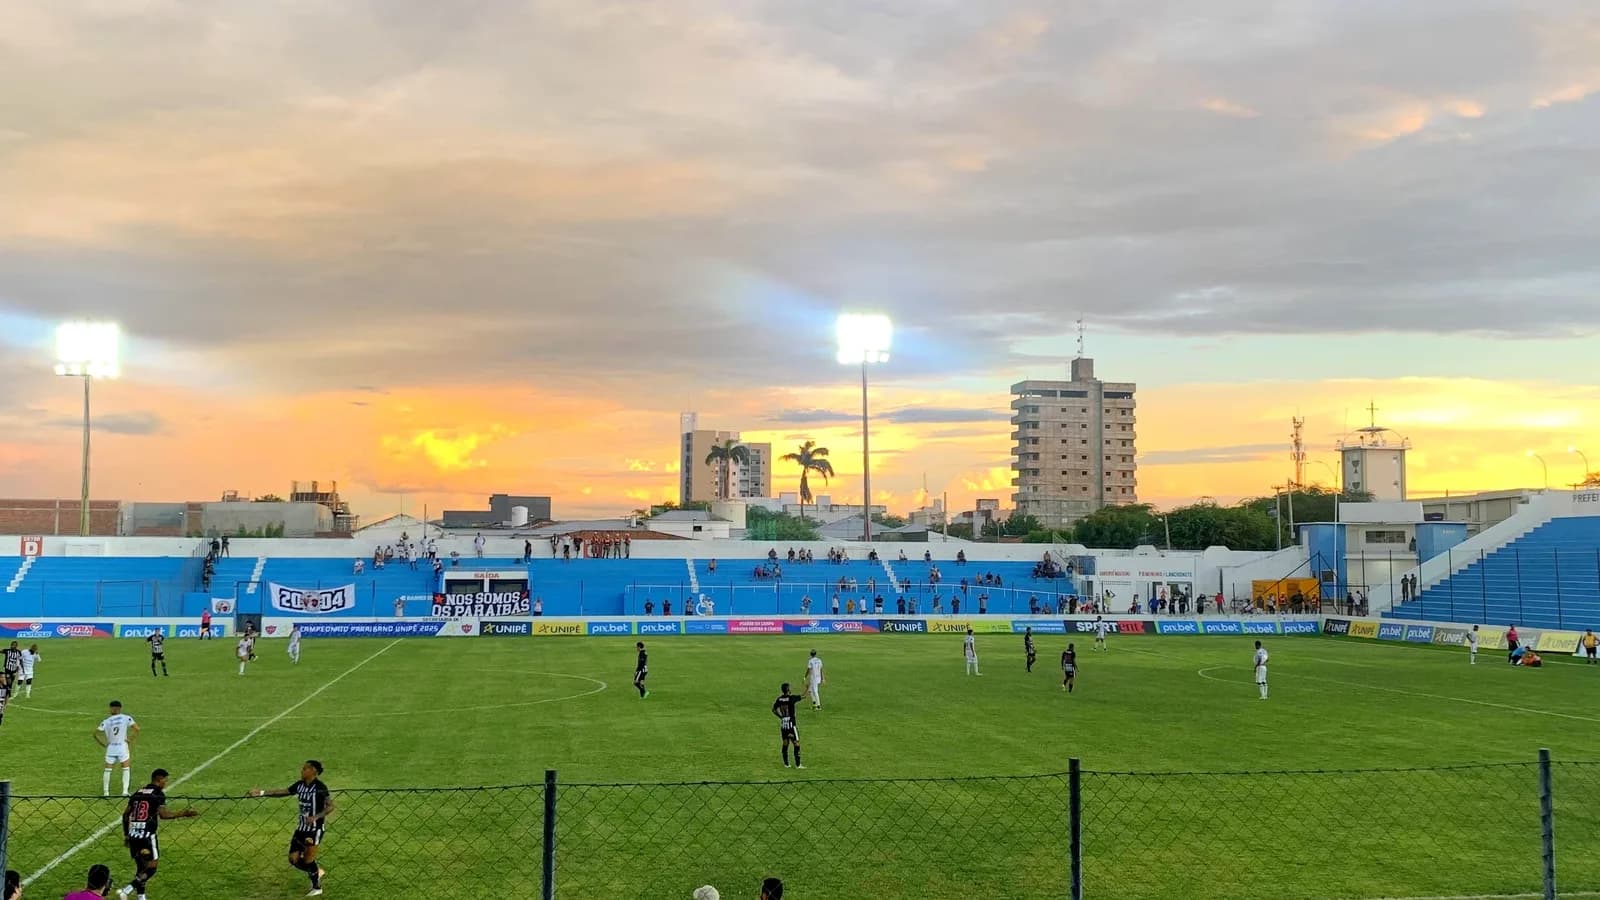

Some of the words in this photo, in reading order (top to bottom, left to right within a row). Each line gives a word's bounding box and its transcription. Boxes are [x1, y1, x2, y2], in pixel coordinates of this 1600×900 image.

[25, 541, 39, 556] D
[475, 592, 521, 604] SOMOS
[432, 604, 451, 617] OS
[496, 624, 527, 633] UNIPÊ
[113, 726, 120, 736] 9
